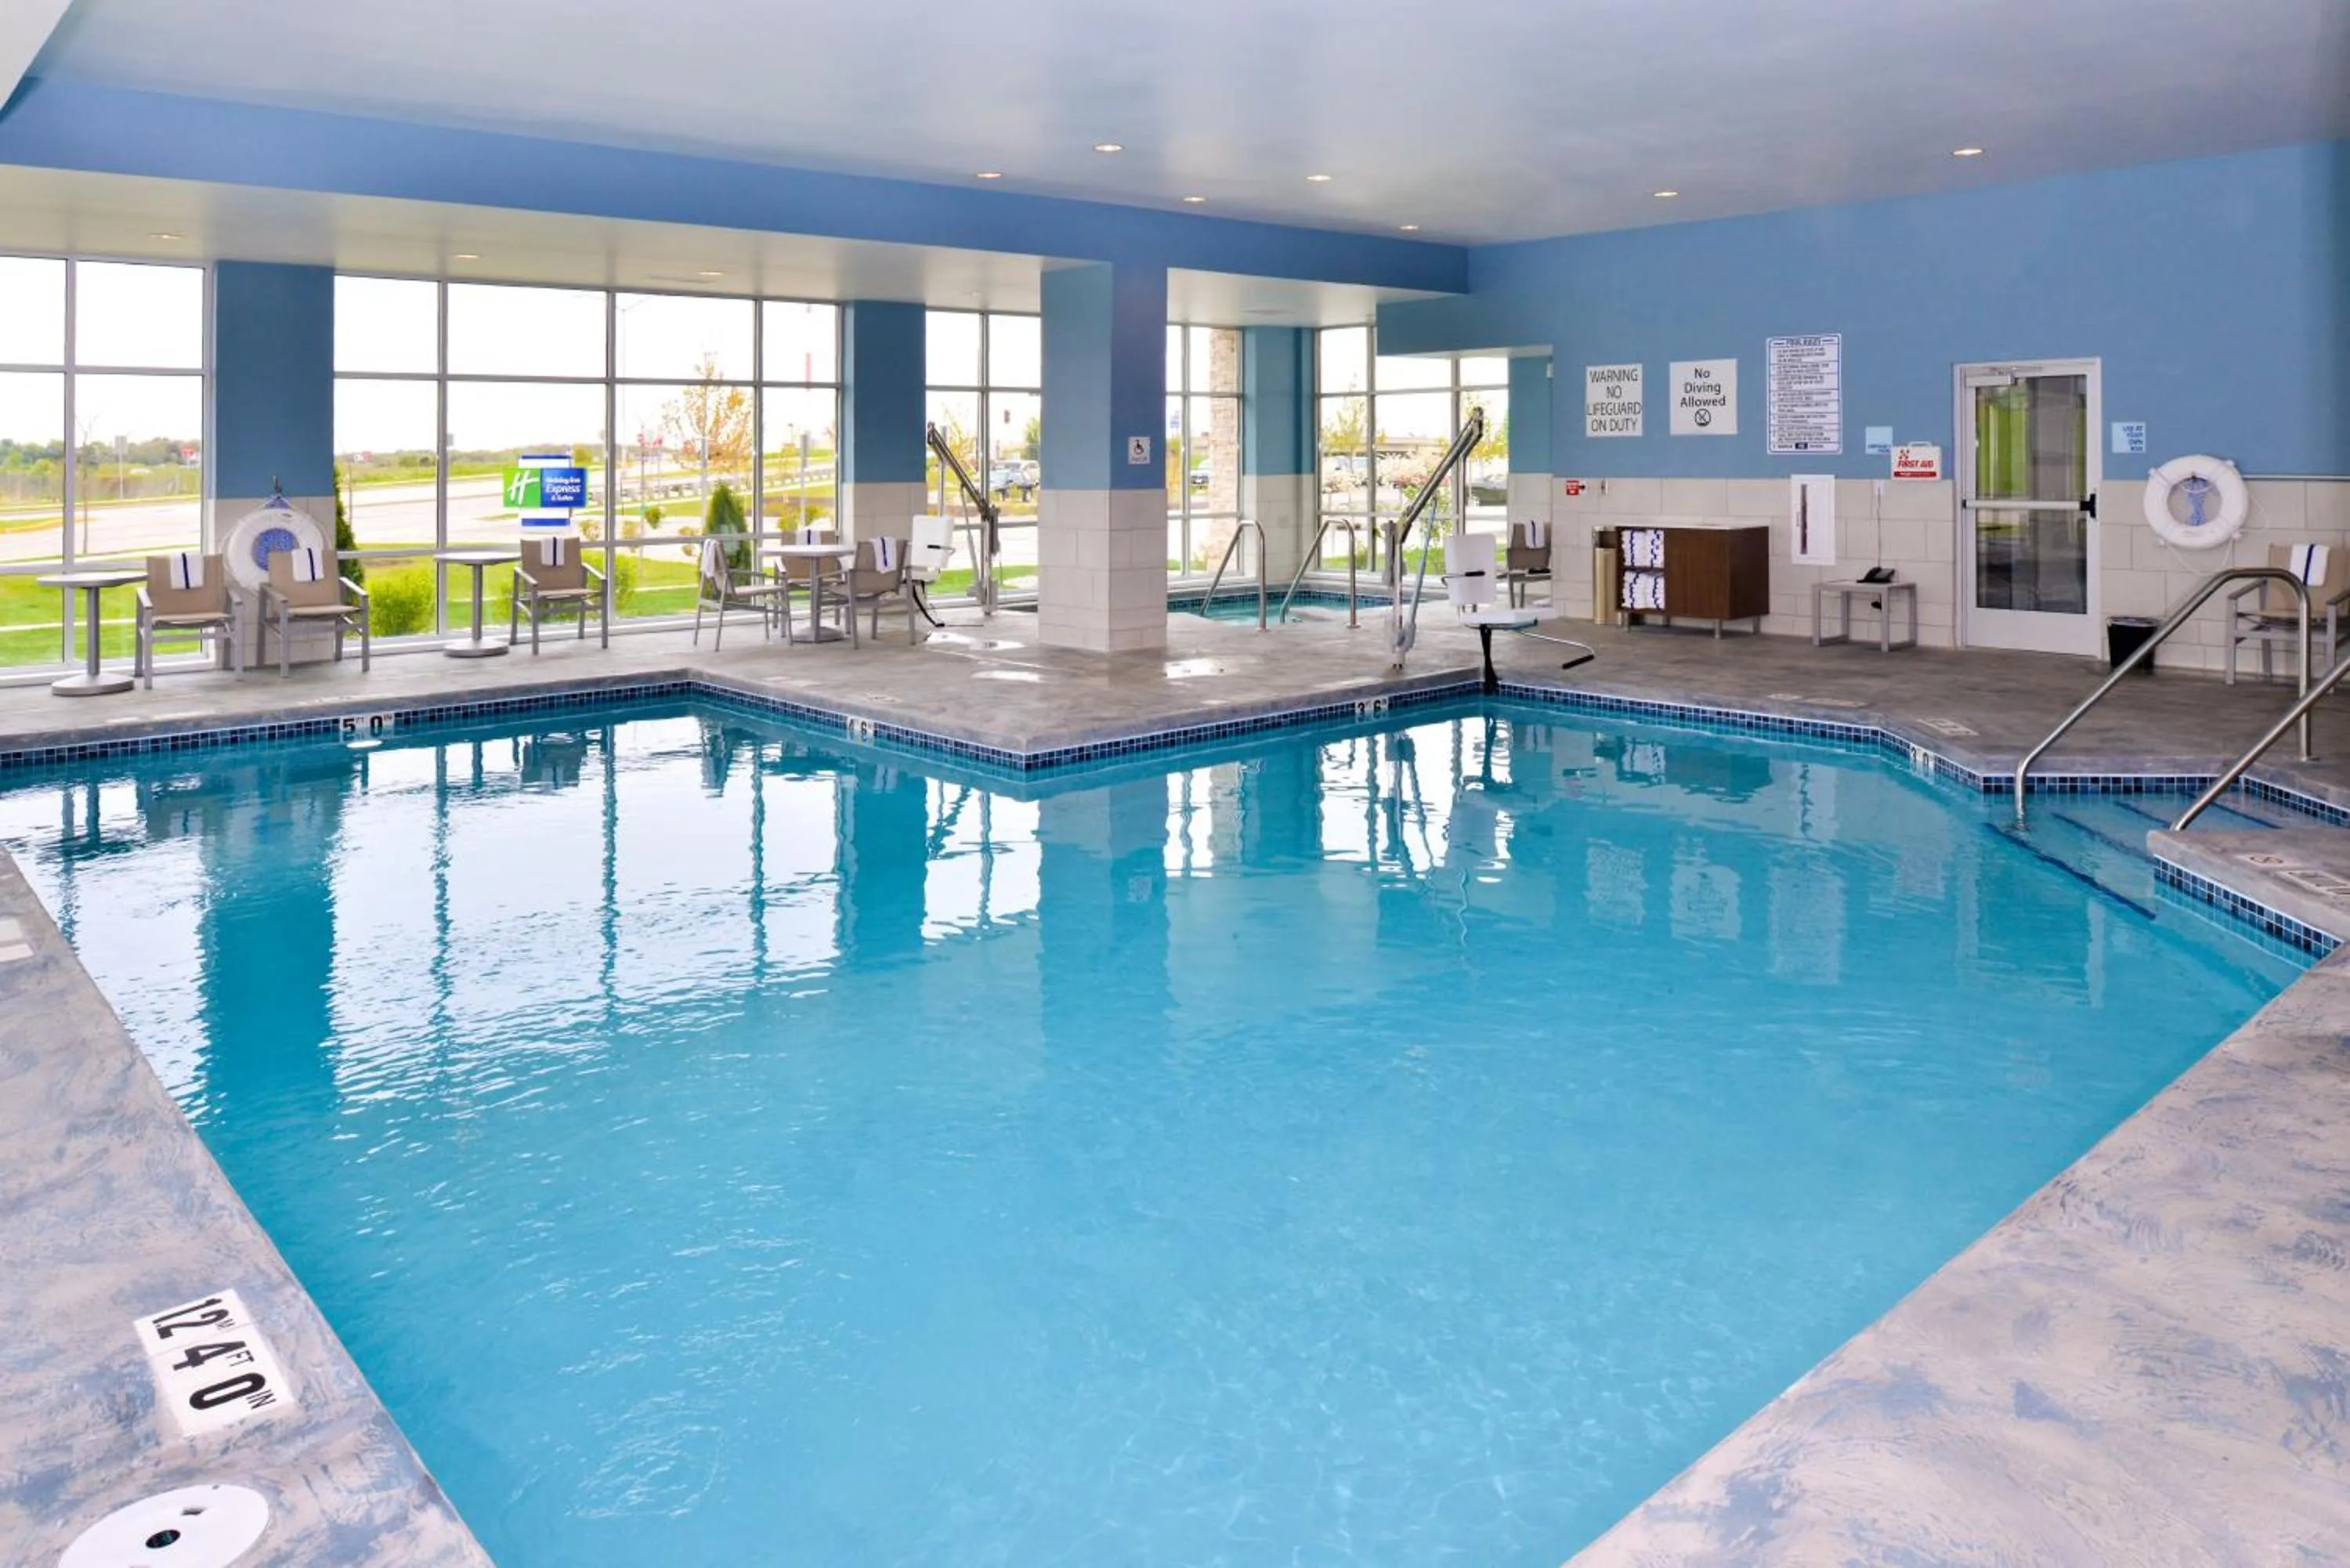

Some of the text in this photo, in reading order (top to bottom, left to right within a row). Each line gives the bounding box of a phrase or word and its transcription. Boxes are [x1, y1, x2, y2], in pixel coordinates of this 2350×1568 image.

[1589, 369, 1638, 383] WARNING
[1694, 368, 1710, 379] No
[1607, 385, 1622, 399] NO
[1684, 382, 1721, 395] Diving
[1680, 396, 1726, 407] Allowed
[1586, 402, 1641, 416] LIFEGUARD
[1591, 418, 1638, 432] ON DUTY
[545, 484, 581, 495] Express
[172, 1341, 247, 1371] 4
[189, 1372, 266, 1411] 0
